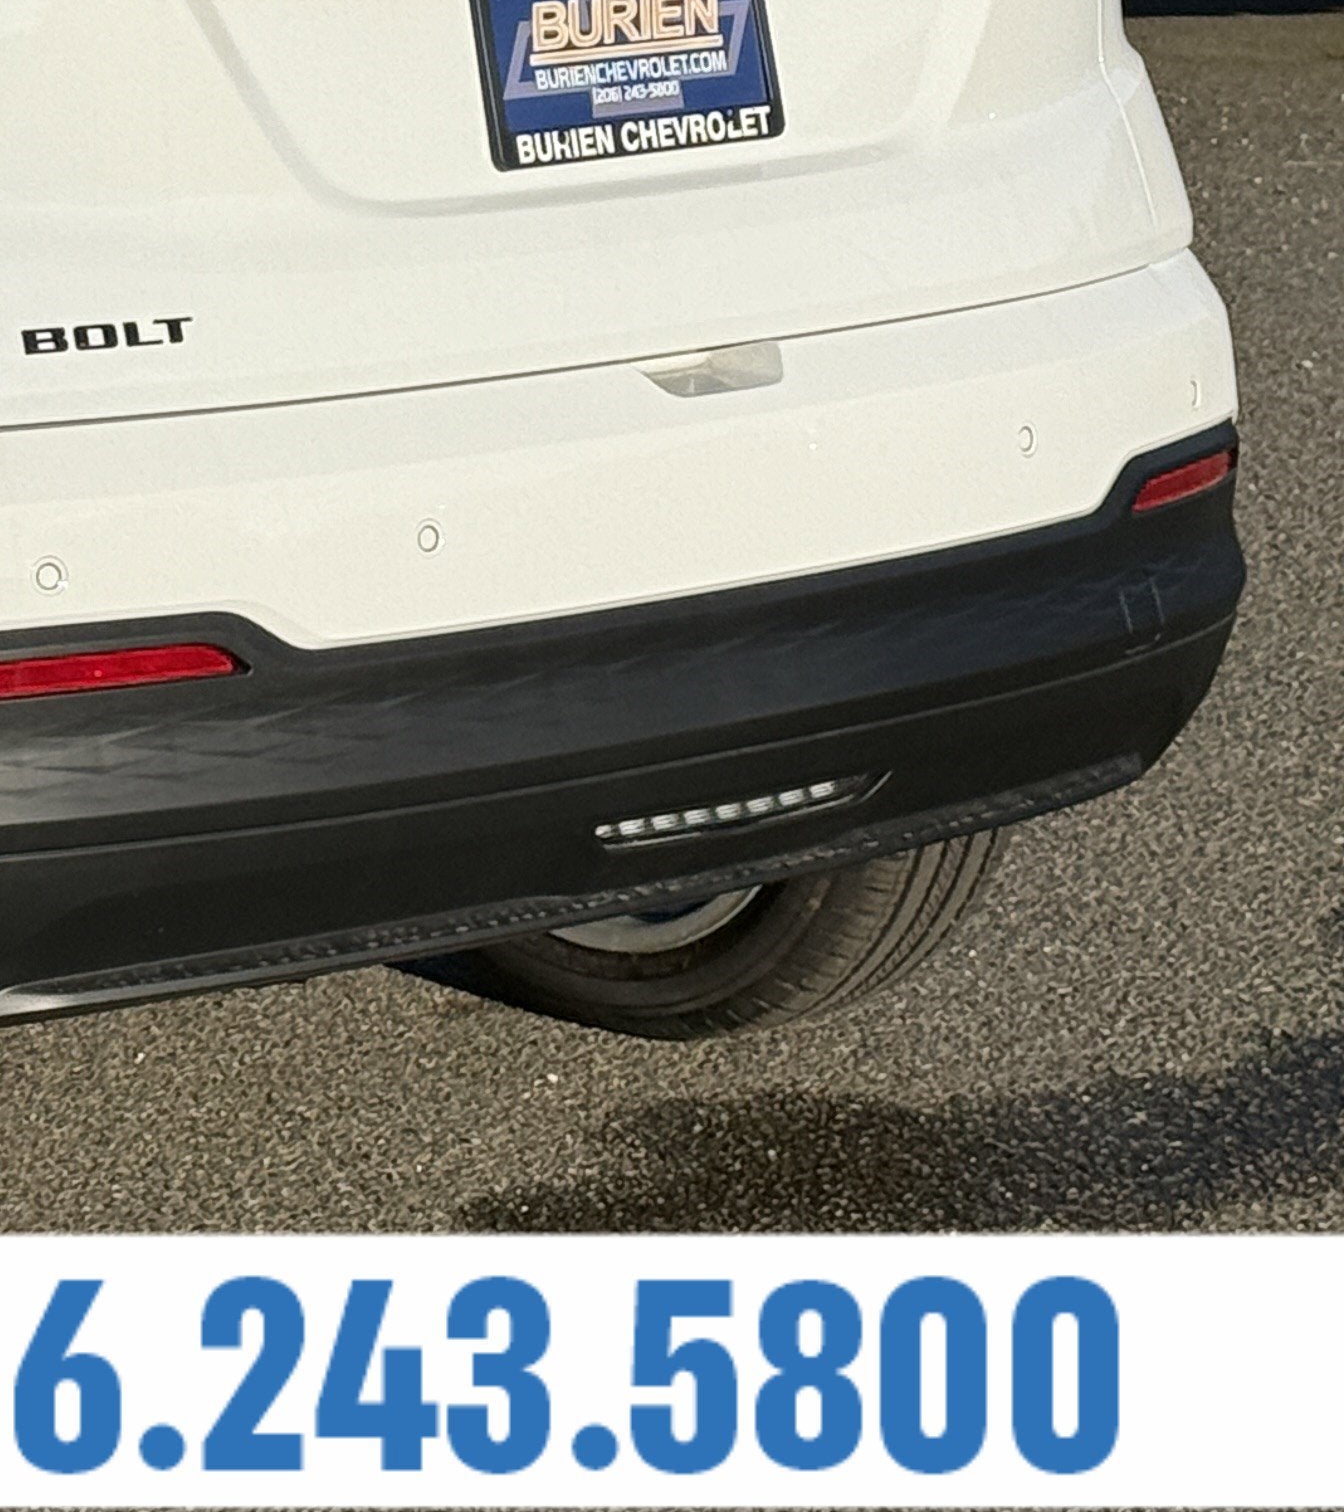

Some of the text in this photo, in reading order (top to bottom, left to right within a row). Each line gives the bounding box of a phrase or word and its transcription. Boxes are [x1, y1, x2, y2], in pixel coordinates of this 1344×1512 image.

[534, 51, 728, 91] BURIENCHEVROLET.COM
[516, 106, 772, 165] BURIEN CHEVROLET
[21, 316, 193, 355] BOLT
